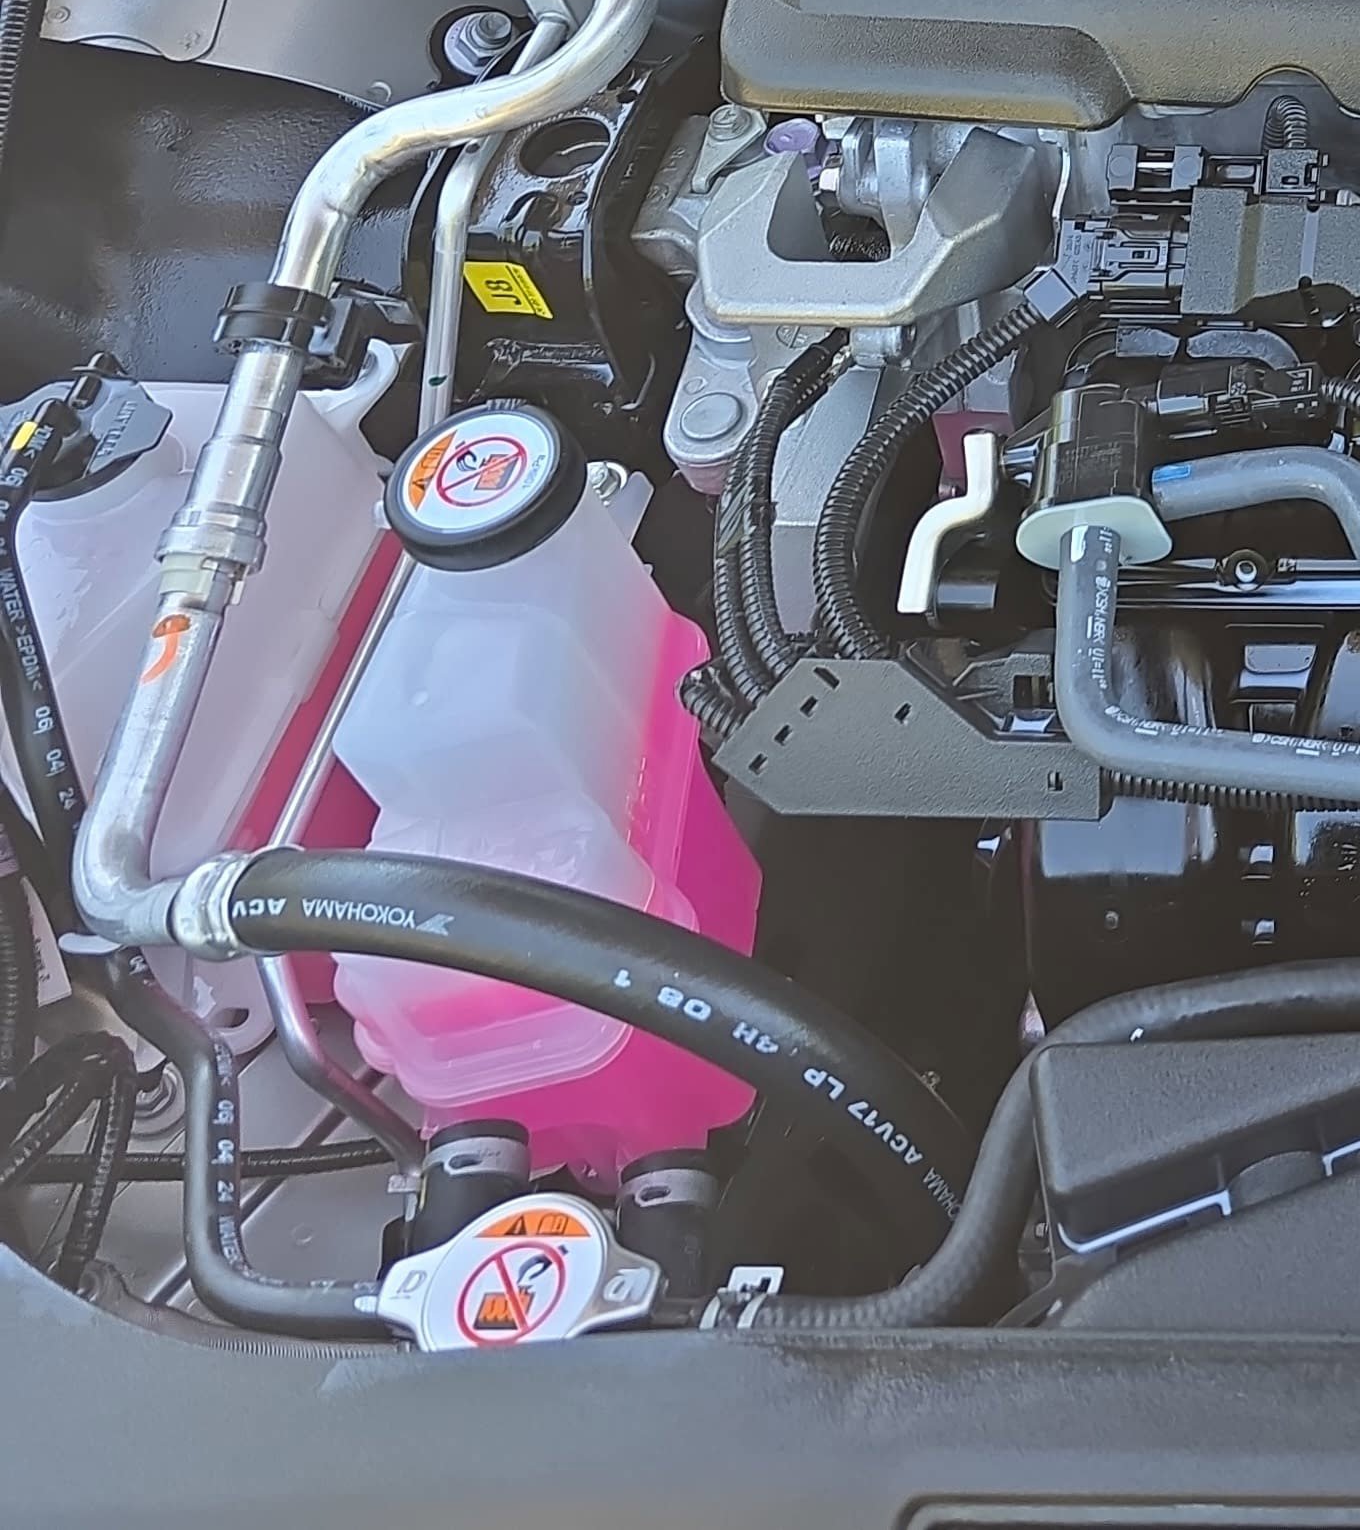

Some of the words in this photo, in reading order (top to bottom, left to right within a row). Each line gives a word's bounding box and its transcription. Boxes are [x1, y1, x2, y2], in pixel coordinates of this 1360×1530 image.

[484, 279, 522, 306] J8
[302, 897, 417, 929] YOKOHAMA
[802, 1066, 846, 1100] LP
[847, 1100, 924, 1165] ACV17
